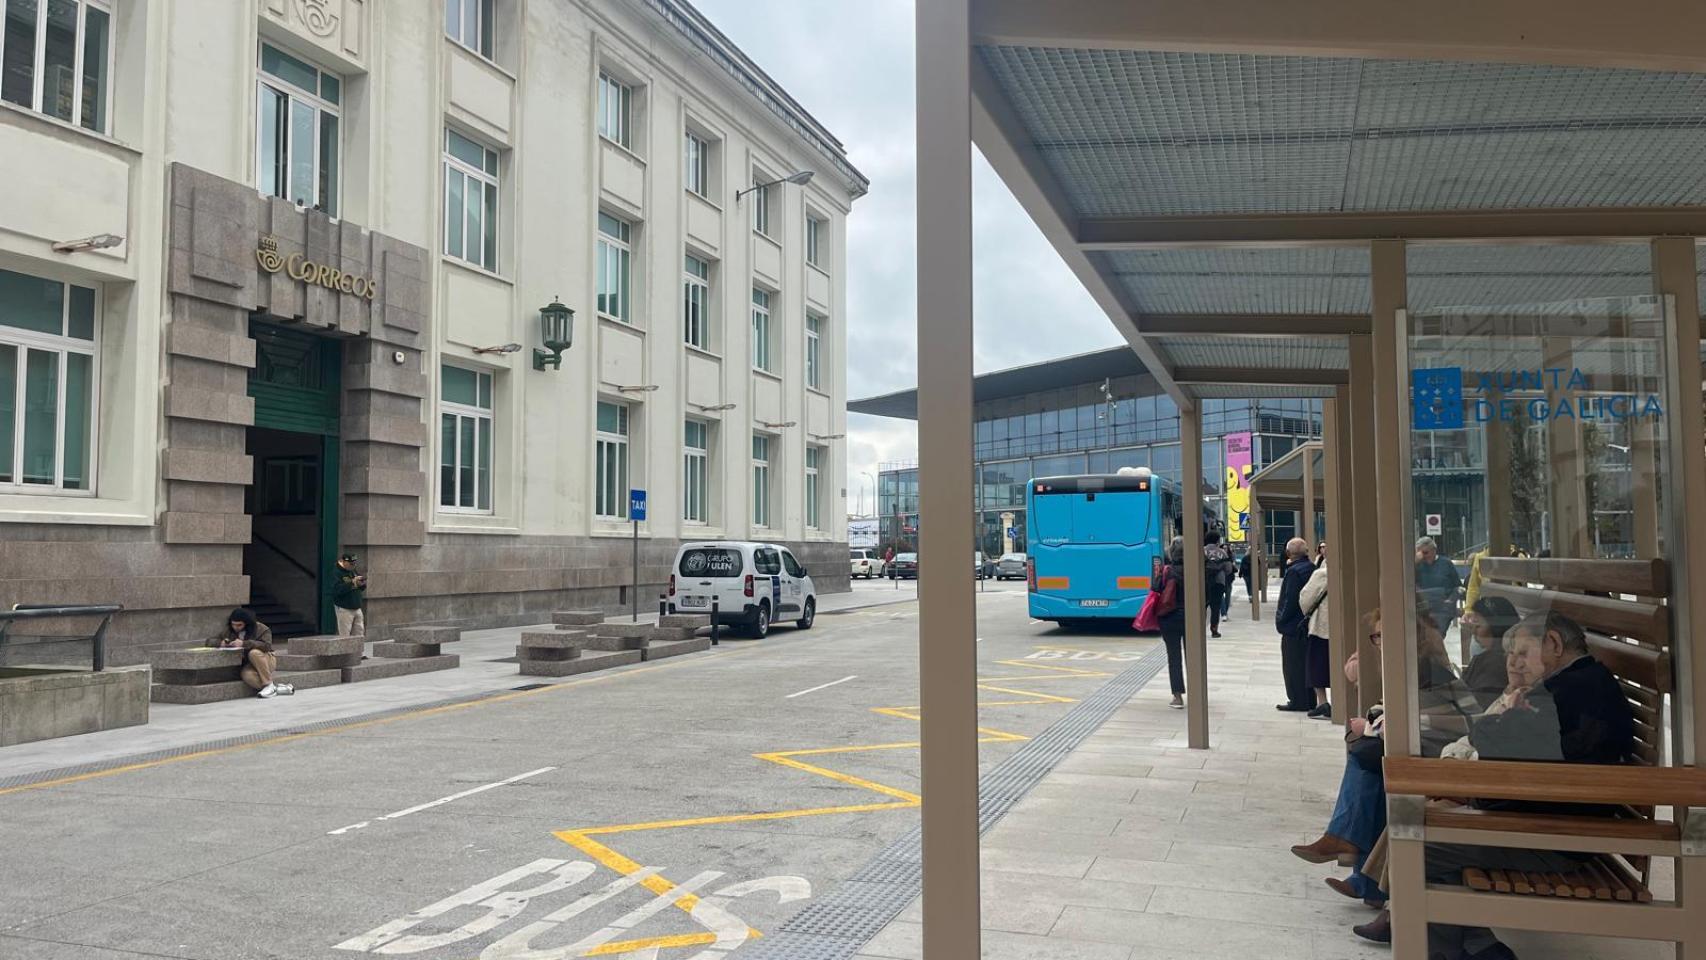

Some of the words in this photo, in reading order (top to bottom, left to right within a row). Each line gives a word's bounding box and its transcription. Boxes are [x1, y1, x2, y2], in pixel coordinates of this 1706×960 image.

[287, 252, 376, 299] CORREOS
[1475, 367, 1587, 393] XUNTA
[1475, 399, 1514, 422] DE
[1527, 394, 1663, 421] GALICIA
[632, 500, 646, 510] TAXI
[1024, 650, 1144, 661] BUS
[331, 857, 812, 960] BUS
